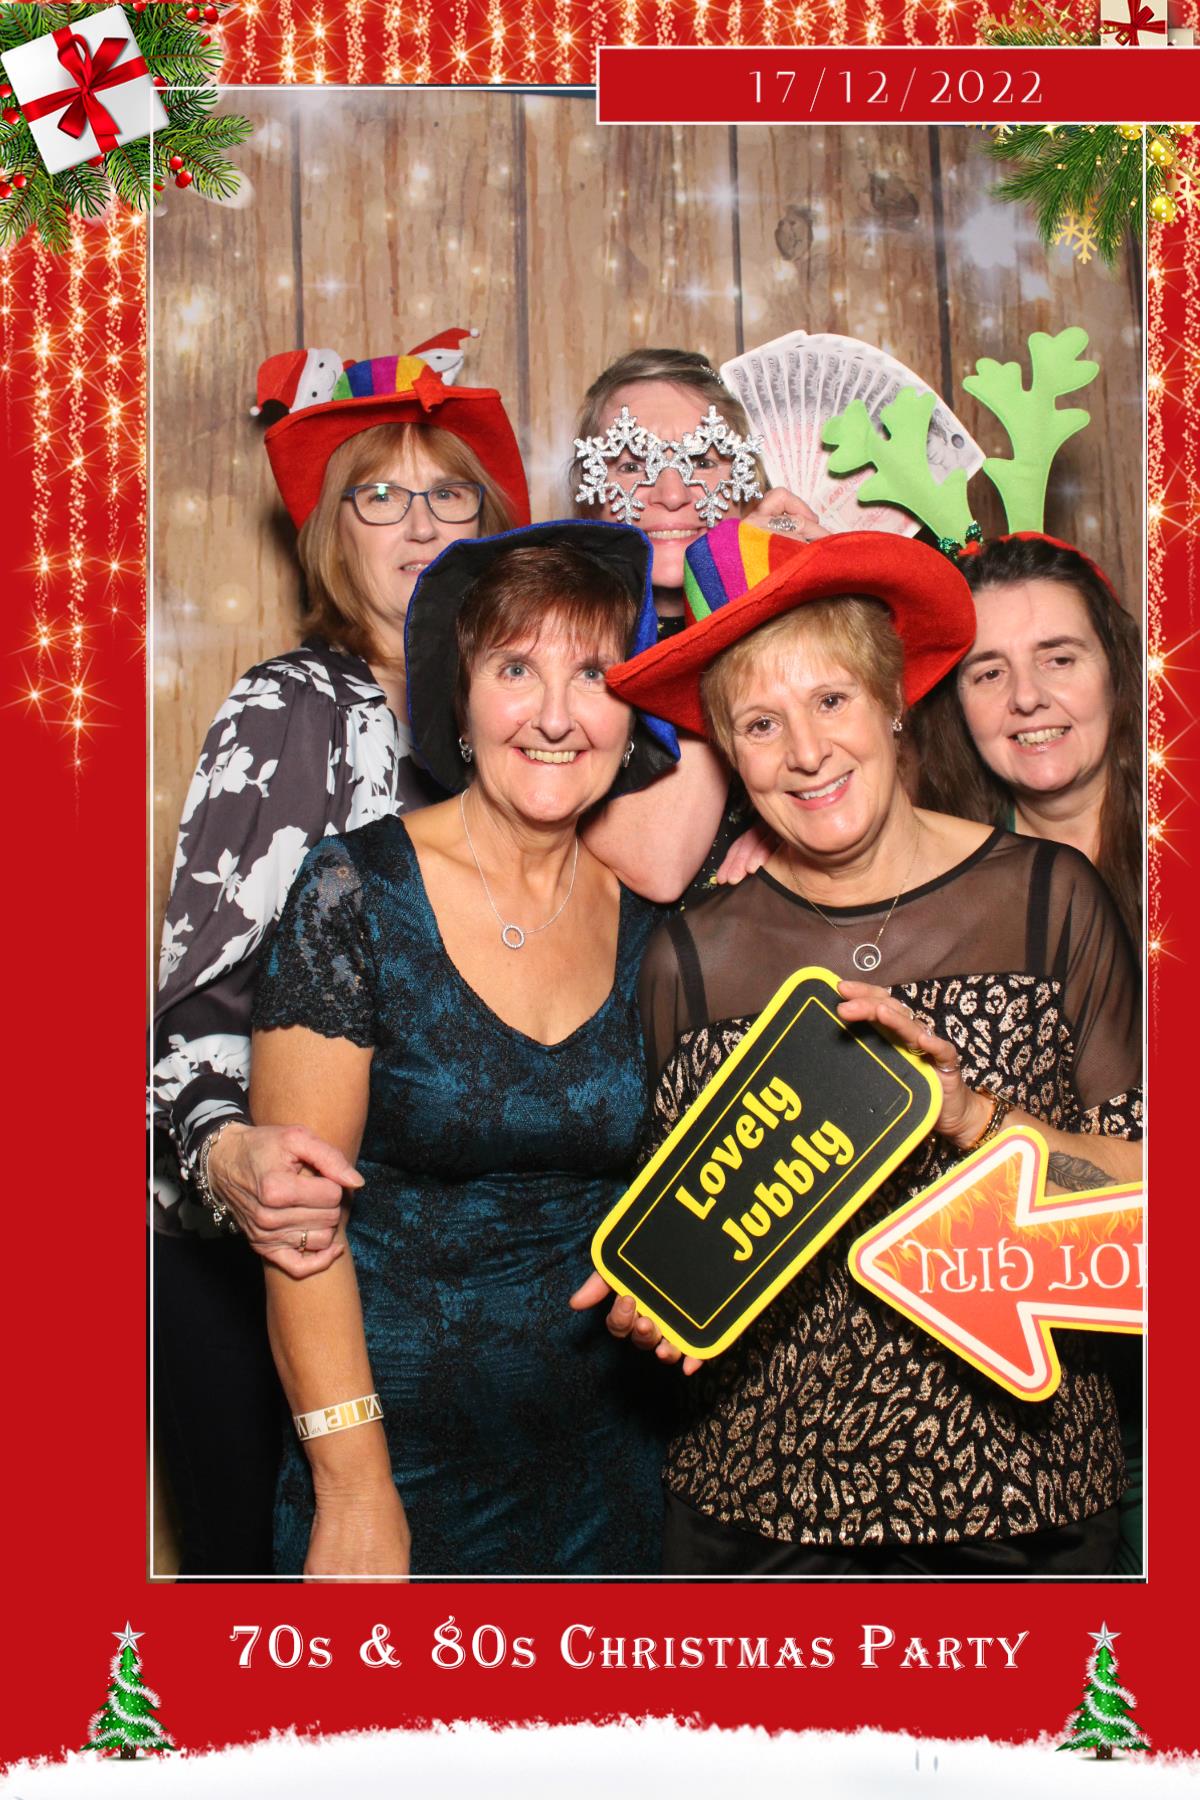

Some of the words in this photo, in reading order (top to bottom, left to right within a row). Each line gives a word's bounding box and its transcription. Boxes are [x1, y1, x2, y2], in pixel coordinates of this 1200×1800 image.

[674, 1076, 803, 1221] Lovely
[721, 1119, 855, 1261] Jubbly
[903, 1237, 1035, 1294] GIRL
[324, 1395, 383, 1430] VIP
